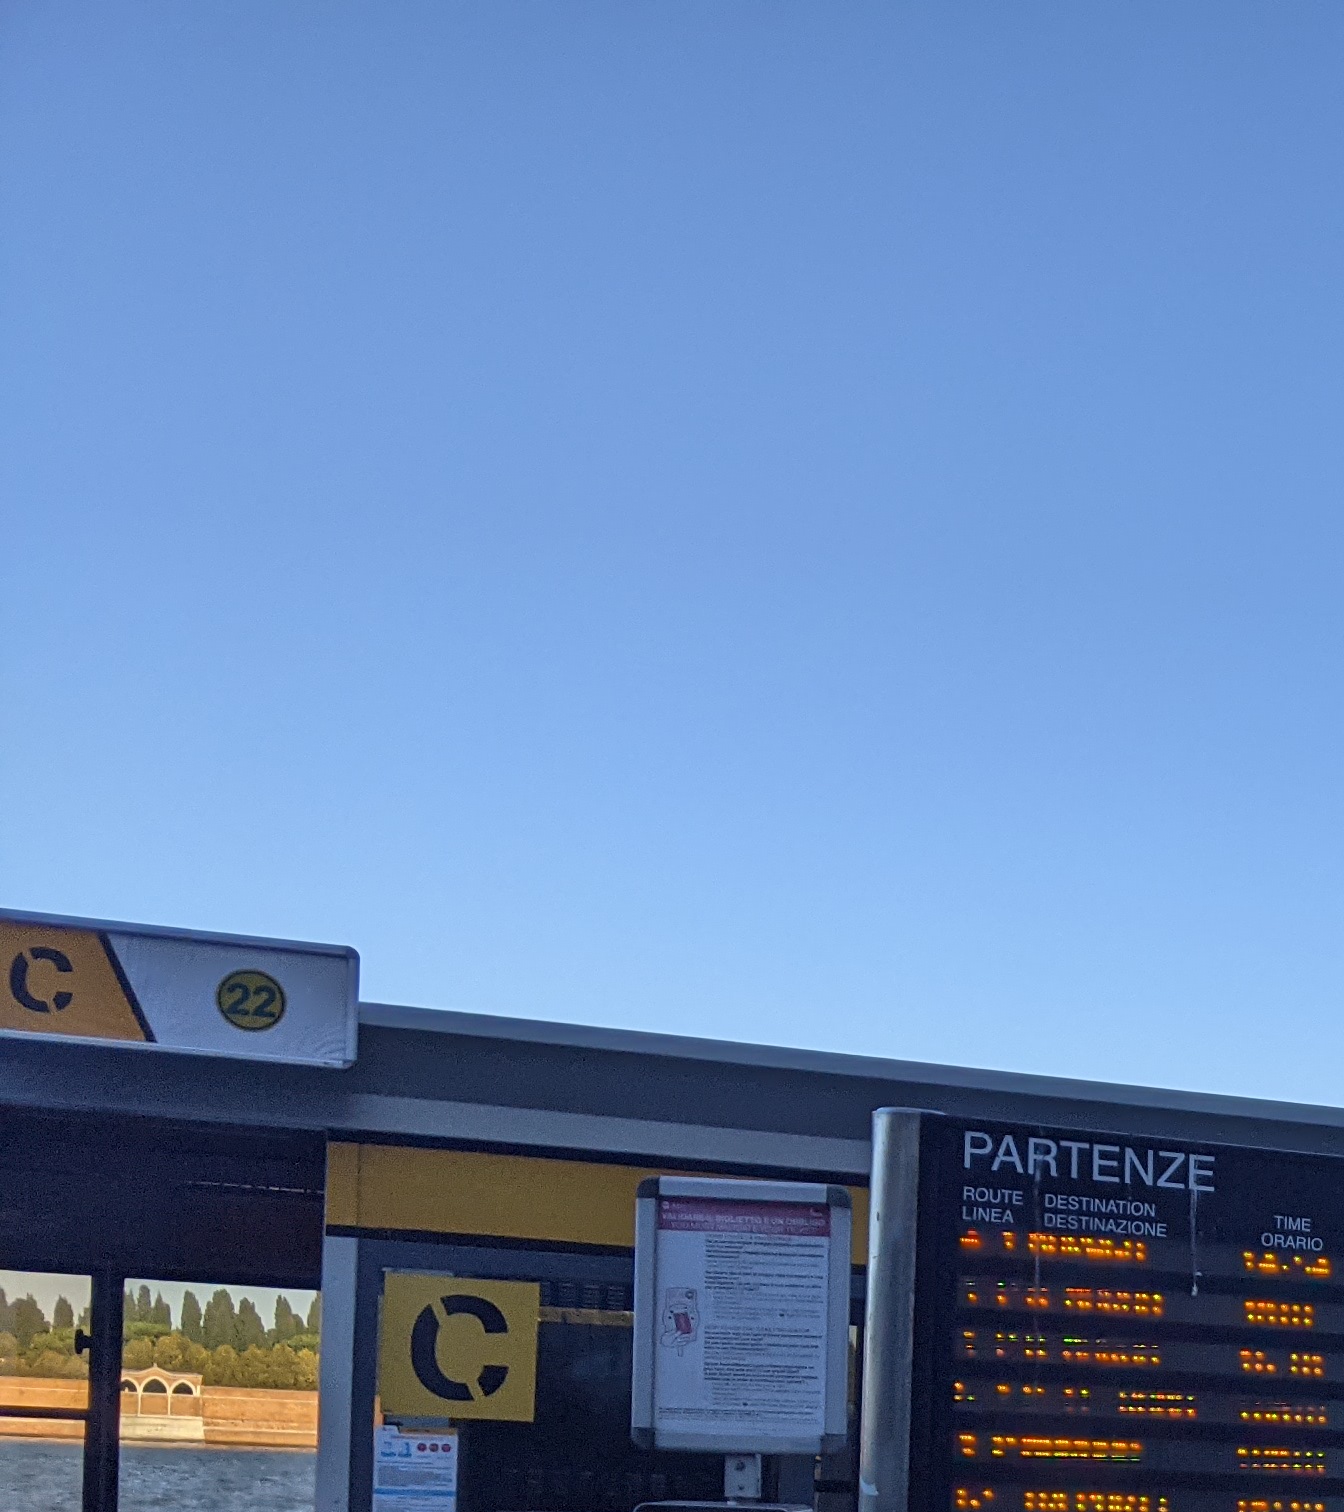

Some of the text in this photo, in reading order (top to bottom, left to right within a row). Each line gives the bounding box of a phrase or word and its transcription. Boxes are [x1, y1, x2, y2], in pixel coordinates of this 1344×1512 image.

[9, 946, 74, 1014] C
[226, 982, 278, 1018] 22
[963, 1131, 1216, 1192] PARTENZE
[962, 1187, 1156, 1218] ROUTE DESTINATION
[962, 1206, 1168, 1238] LINEA DESTINAZIONE
[1273, 1215, 1312, 1233] TIME
[1260, 1233, 1324, 1252] ORARIO
[410, 1294, 508, 1401] C
